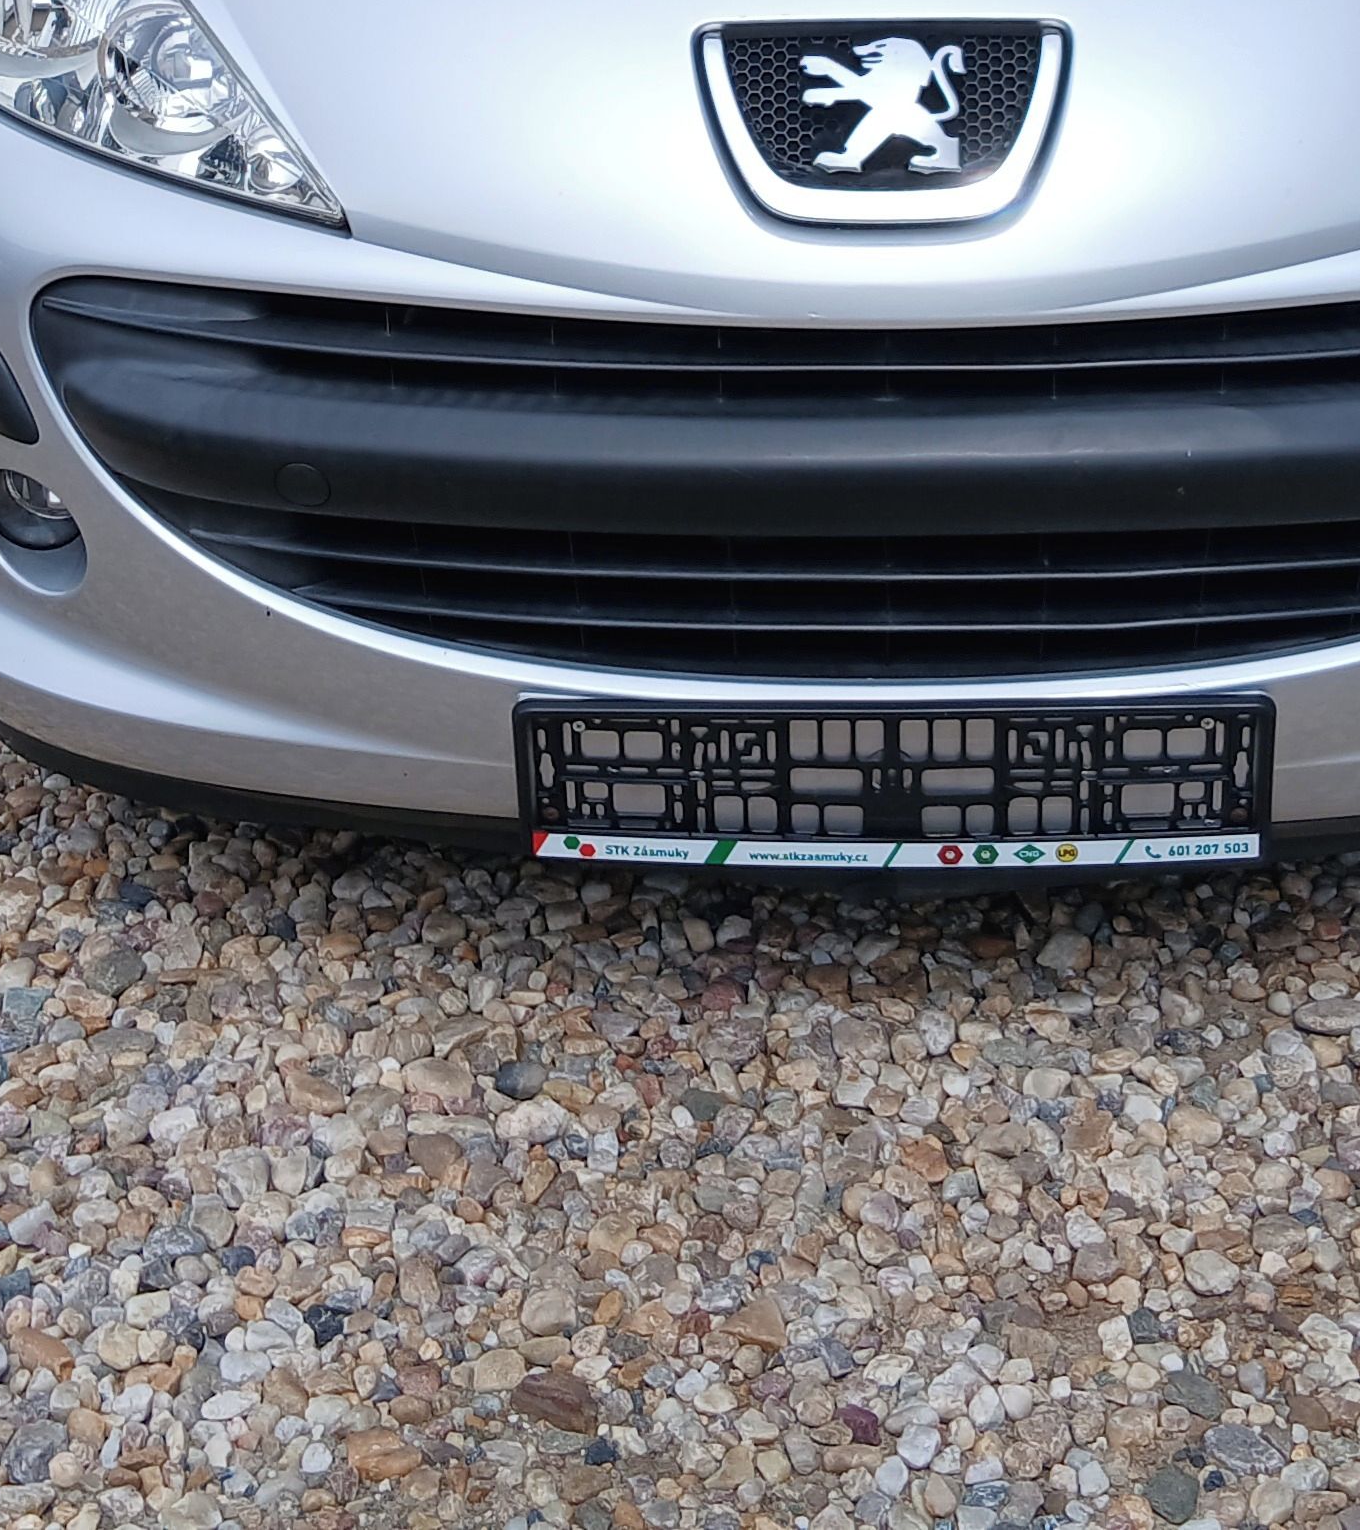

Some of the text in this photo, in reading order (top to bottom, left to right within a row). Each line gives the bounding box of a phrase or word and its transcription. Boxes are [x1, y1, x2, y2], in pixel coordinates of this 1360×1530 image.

[605, 844, 630, 856] STK
[1057, 848, 1077, 858] LPG
[1168, 842, 1249, 856] 601 207 503
[748, 851, 868, 863] www.stkzasmuky.cz
